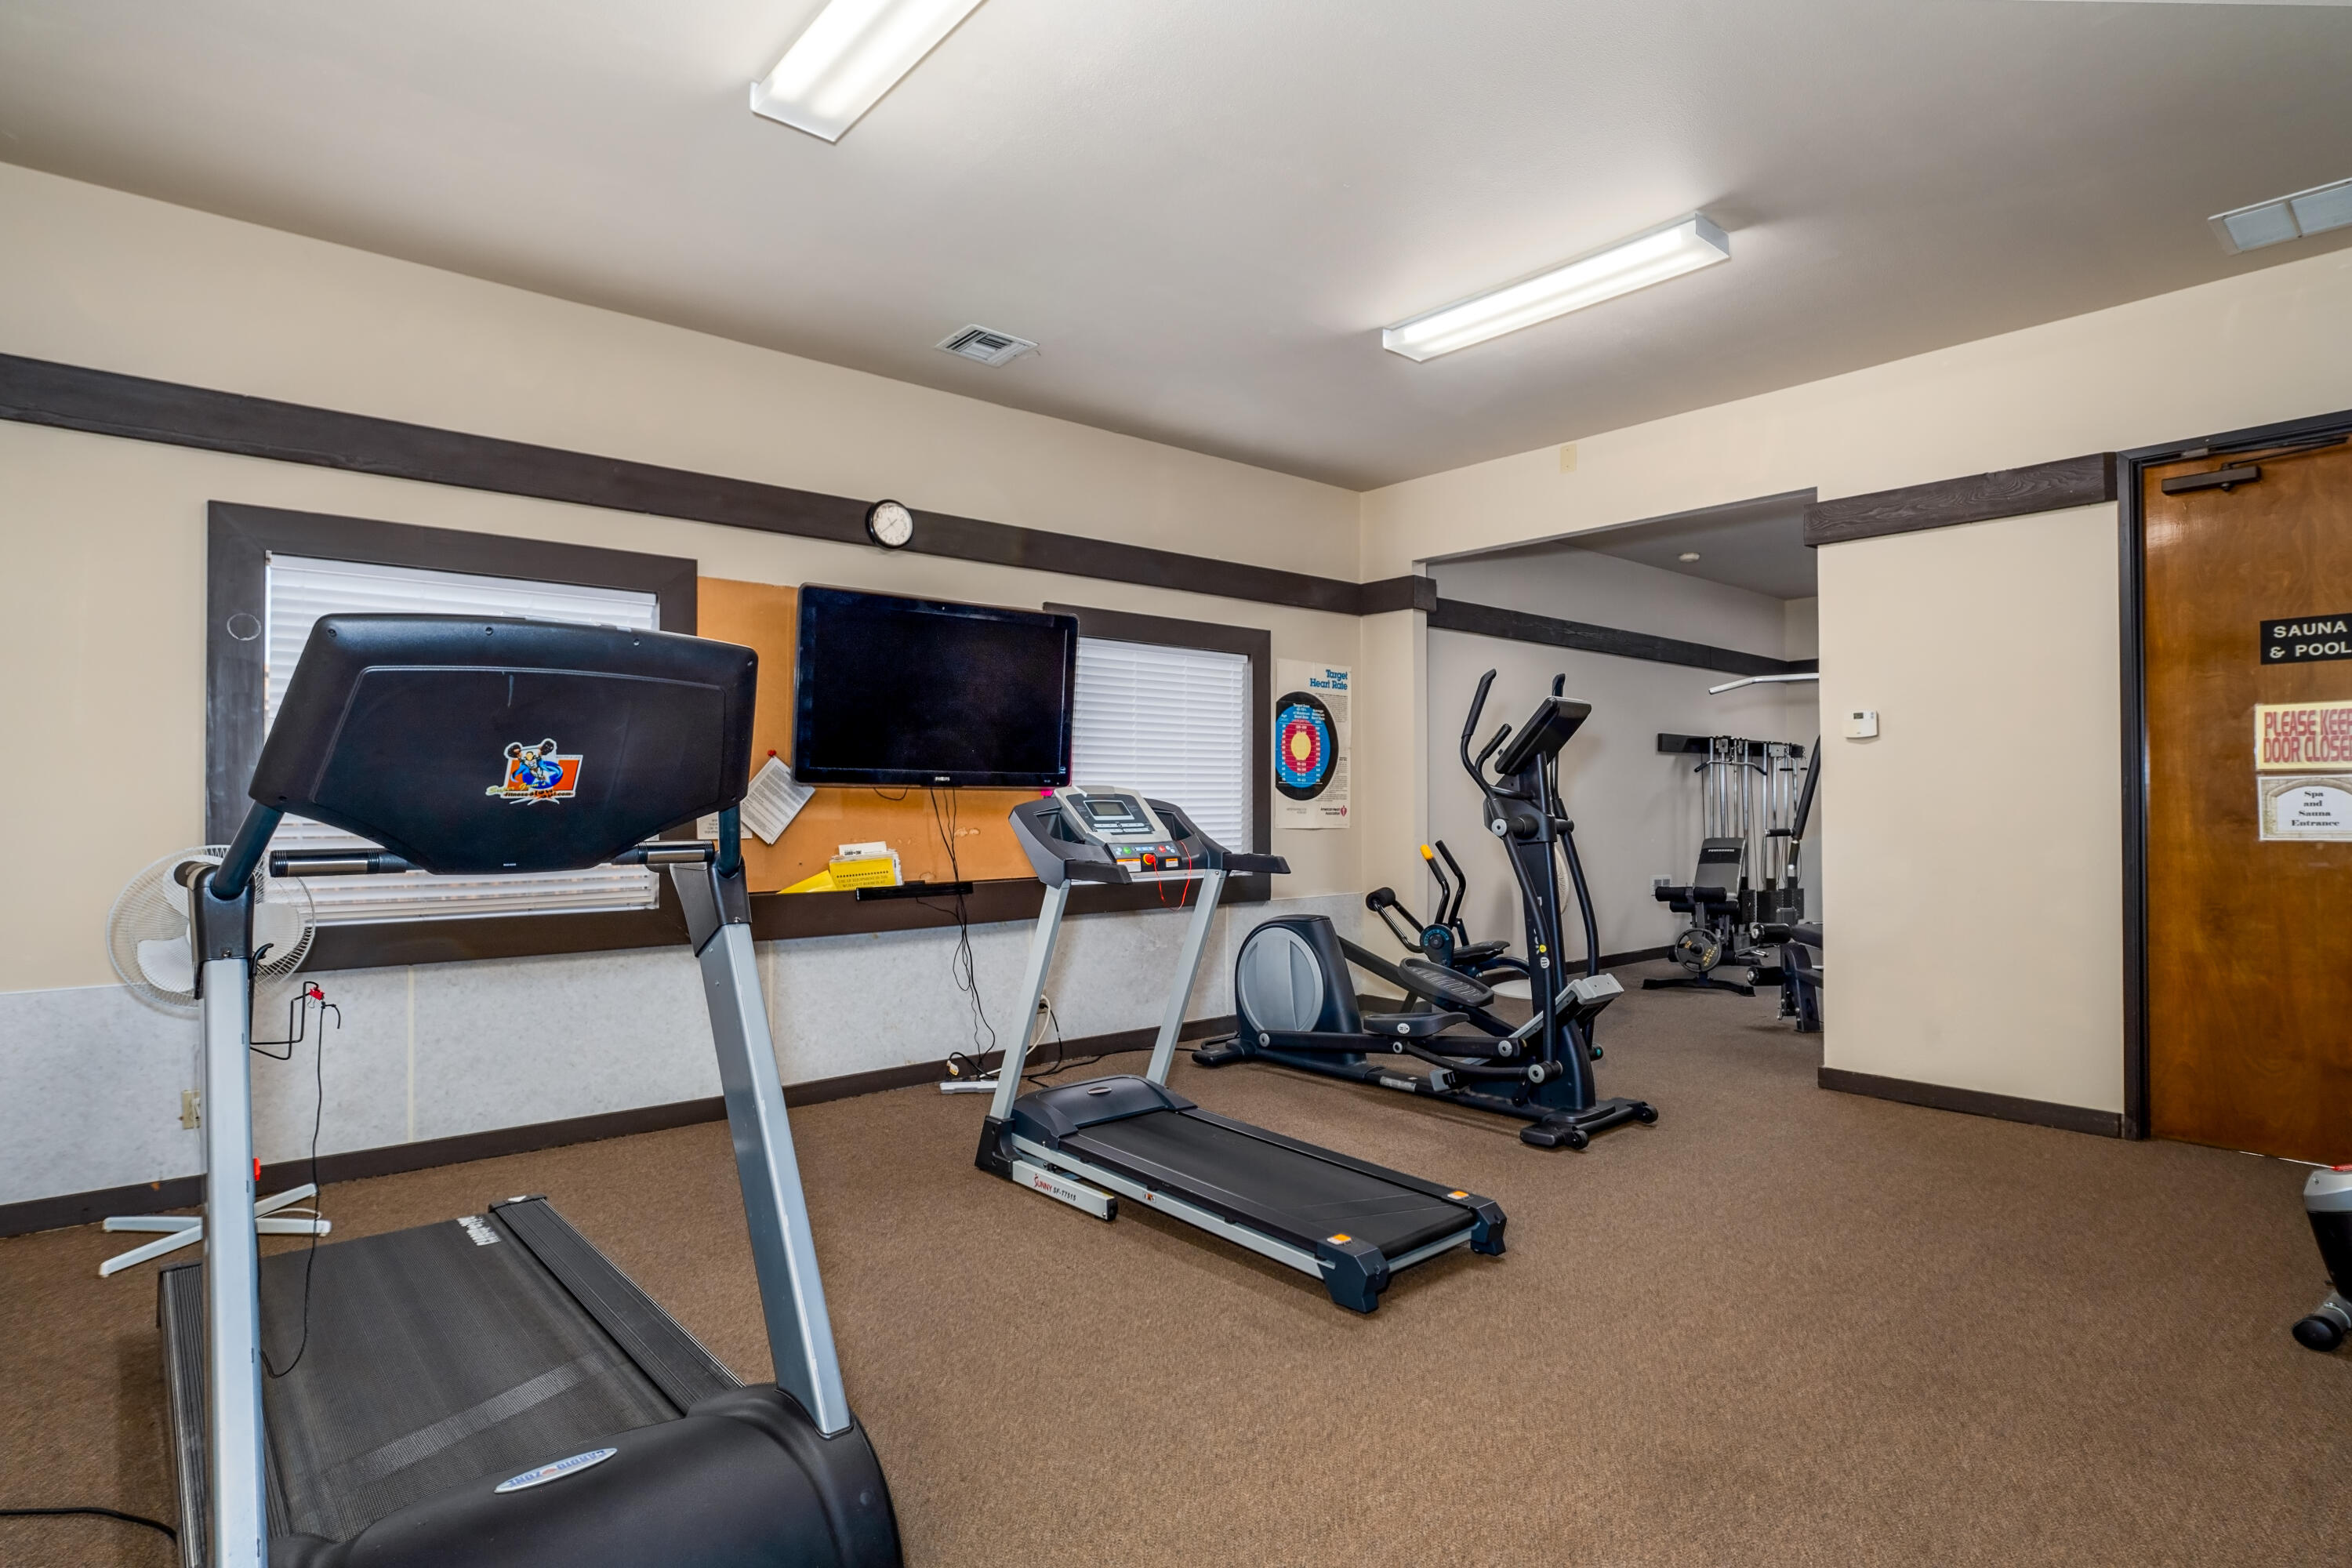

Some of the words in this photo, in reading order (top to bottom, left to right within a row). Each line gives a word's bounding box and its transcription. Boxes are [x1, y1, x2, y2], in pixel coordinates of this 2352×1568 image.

[2274, 620, 2348, 638] SAUNA
[2270, 646, 2285, 659] &
[2295, 641, 2352, 657] POOL
[1310, 677, 1330, 688] Heart
[1332, 680, 1348, 690] Rate
[1326, 669, 1348, 681] Target
[2264, 710, 2316, 738] PLEASE
[2263, 736, 2301, 763] DOOR
